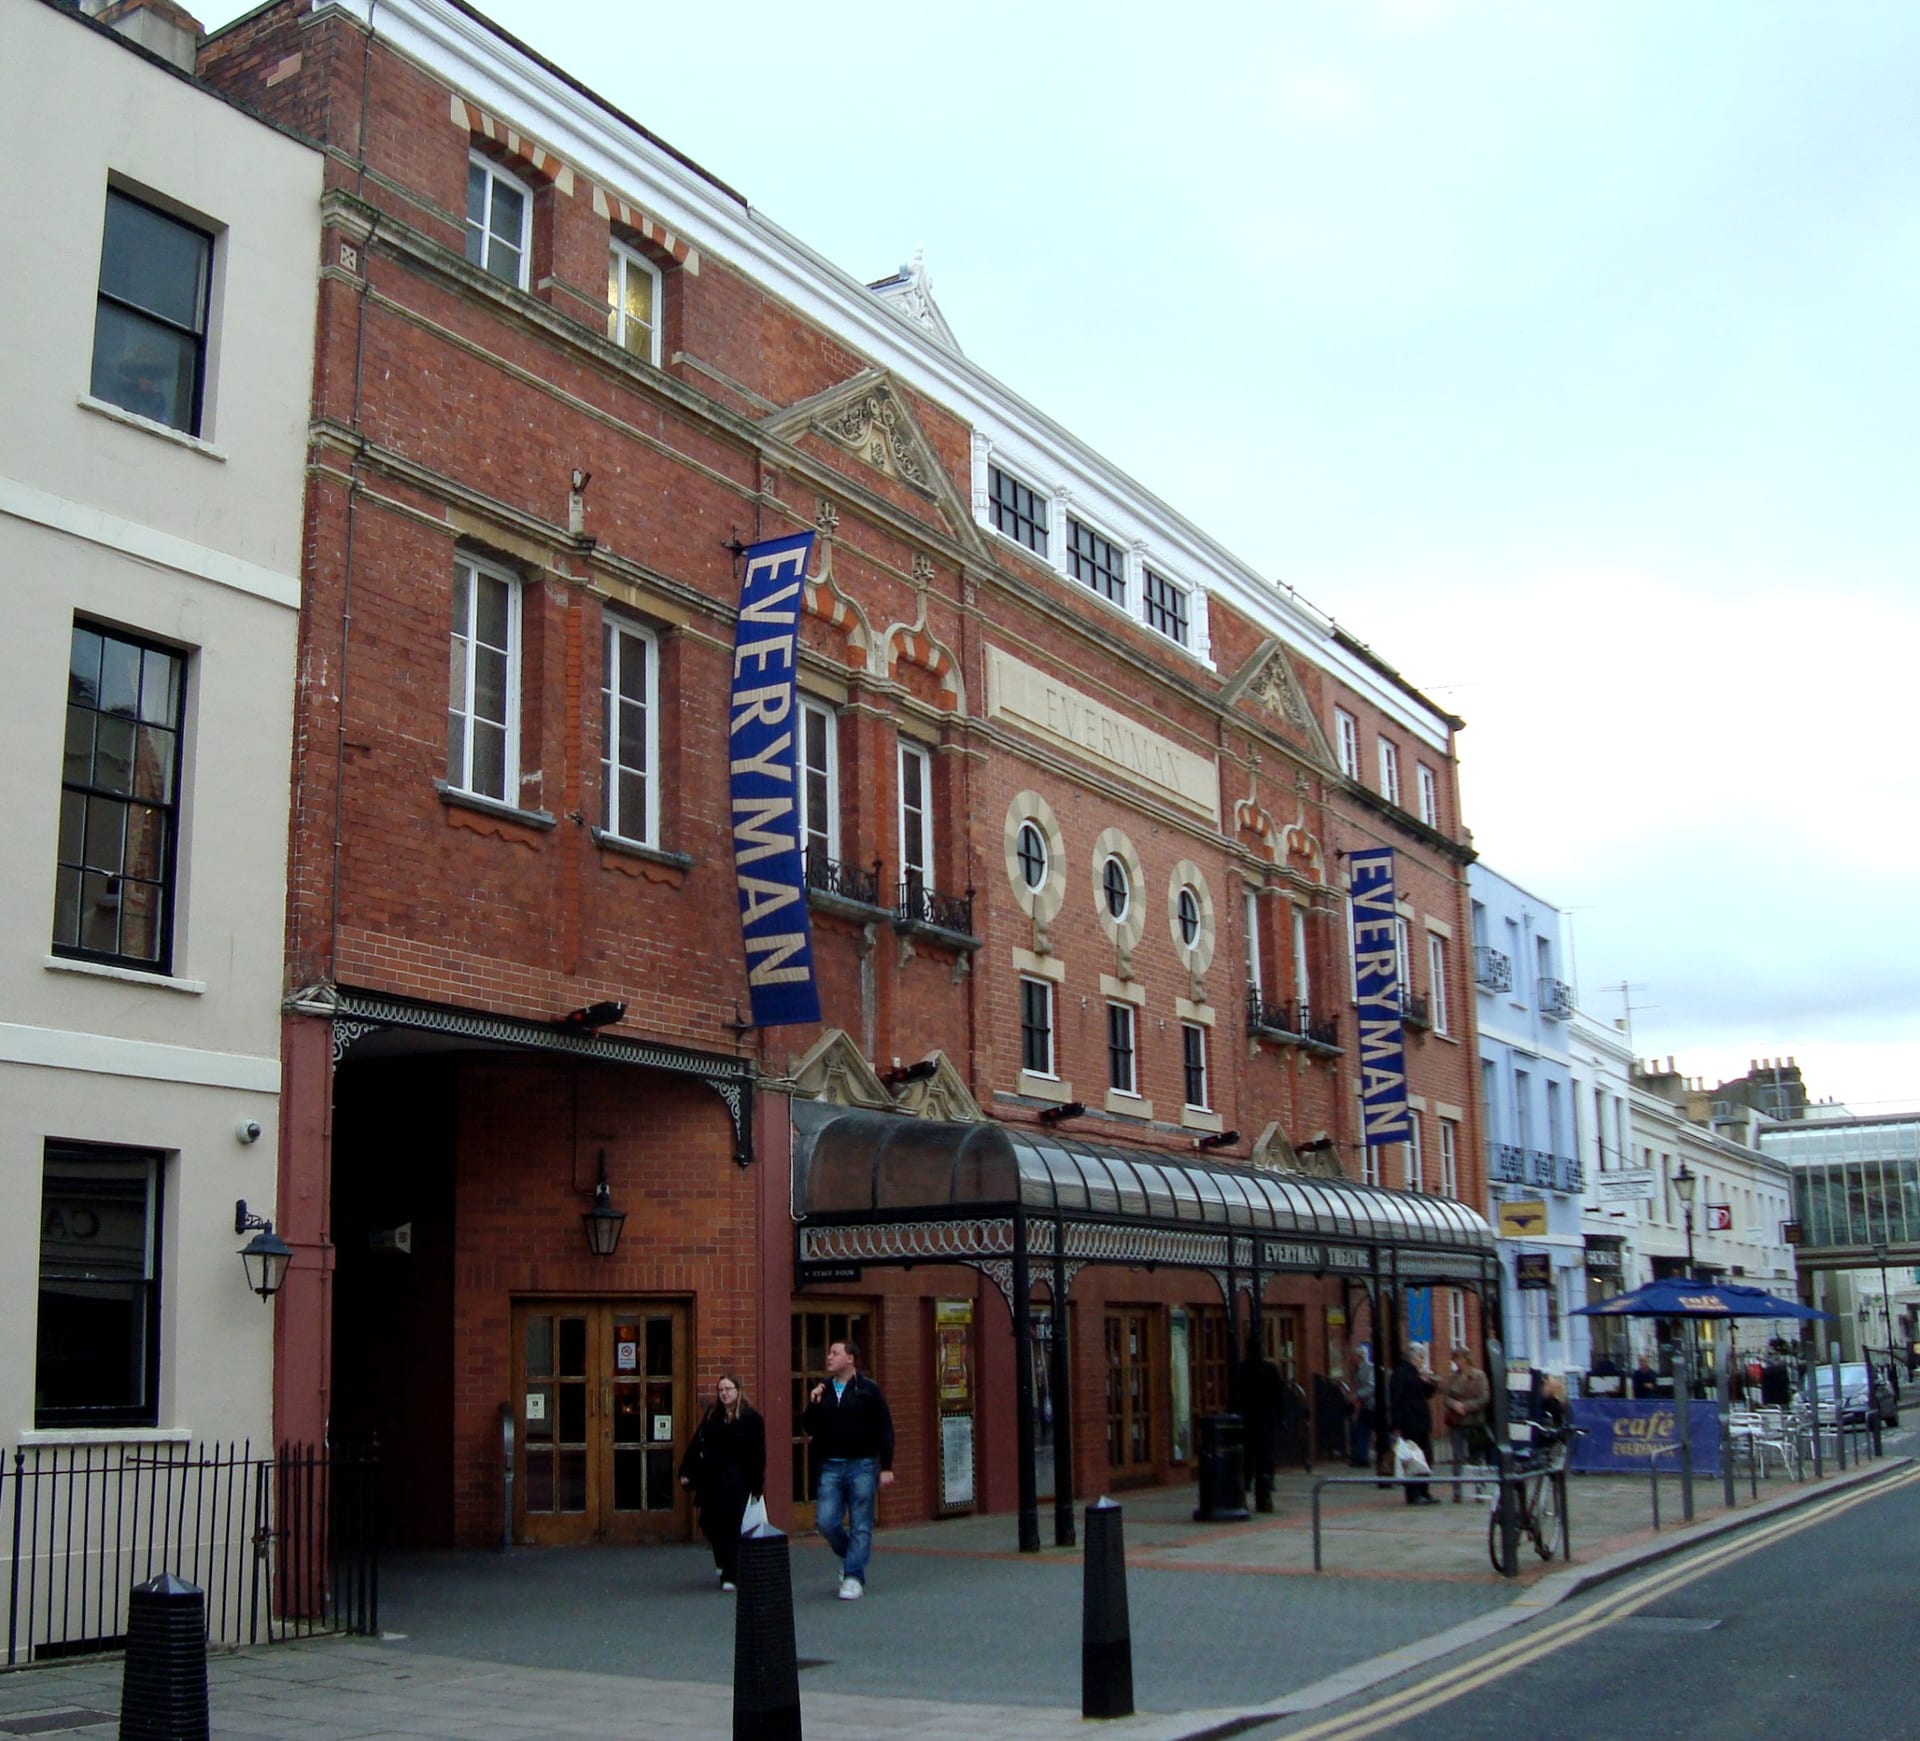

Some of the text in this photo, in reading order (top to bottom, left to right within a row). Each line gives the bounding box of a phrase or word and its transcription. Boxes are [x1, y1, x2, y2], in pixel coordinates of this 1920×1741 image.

[730, 545, 810, 987] EVERYMAN
[1045, 687, 1182, 792] EVERYMAN
[1351, 856, 1408, 1136] EVERYMAN
[1264, 1243, 1371, 1268] EVERYMAN THEATRE
[1613, 1411, 1675, 1441] café
